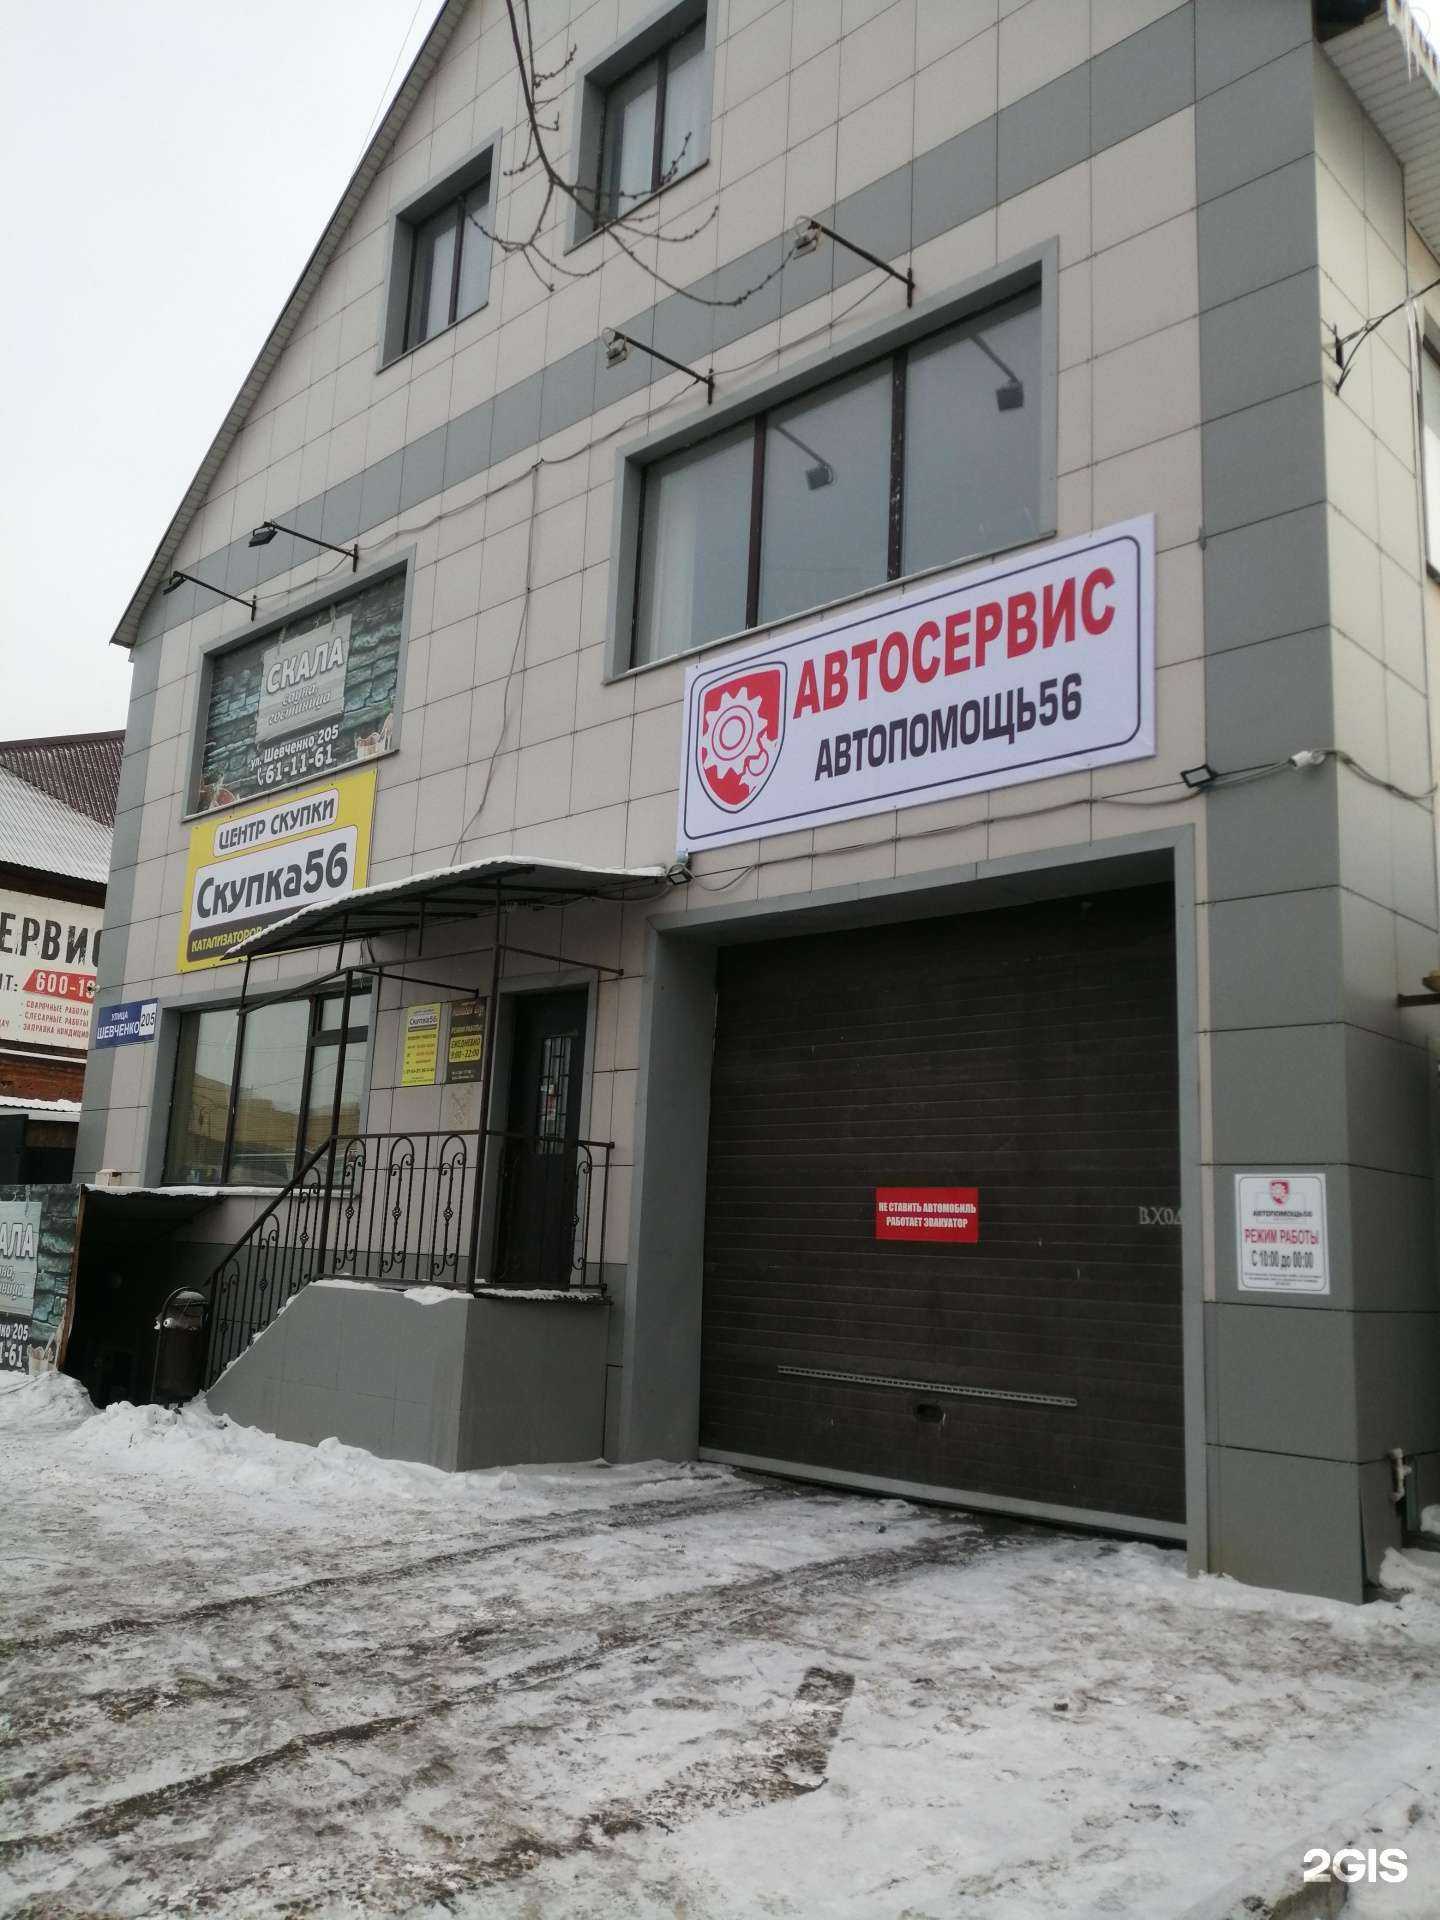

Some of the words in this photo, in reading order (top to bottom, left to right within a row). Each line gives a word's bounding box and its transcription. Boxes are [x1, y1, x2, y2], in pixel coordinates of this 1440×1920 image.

[793, 567, 1115, 719] АВТОСЕРВИС
[265, 637, 345, 694] СКАЛА
[815, 672, 1083, 781] АВТОПОМОЩЬ56
[264, 735, 315, 764] Шевченко
[317, 724, 339, 745] 205
[265, 743, 333, 784] 61-11-61
[218, 821, 266, 850] ЦЕНТР
[270, 798, 335, 835] СКУПКИ
[196, 842, 348, 919] Скупка56
[64, 1017, 89, 1027] РАБОТЫ
[65, 1006, 89, 1016] РАБОТЫ
[96, 1021, 140, 1040] ШЕВЧЕНКО
[140, 1012, 156, 1027] 205
[878, 1202, 888, 1212] НЕ
[888, 1202, 921, 1213] СТАВИТЬ
[922, 1203, 976, 1213] АВТОМОБИЛЬ
[886, 1216, 923, 1227] РАБОТАЕТ
[924, 1218, 969, 1228] ЭВАКУАТОР
[1244, 1228, 1278, 1243] РЕЖИМ
[1280, 1229, 1319, 1245] РАБОТЫ
[1259, 1250, 1280, 1267] 10:00
[1281, 1255, 1291, 1269] до
[1293, 1251, 1314, 1268] 00:00
[12, 1322, 29, 1341] 205
